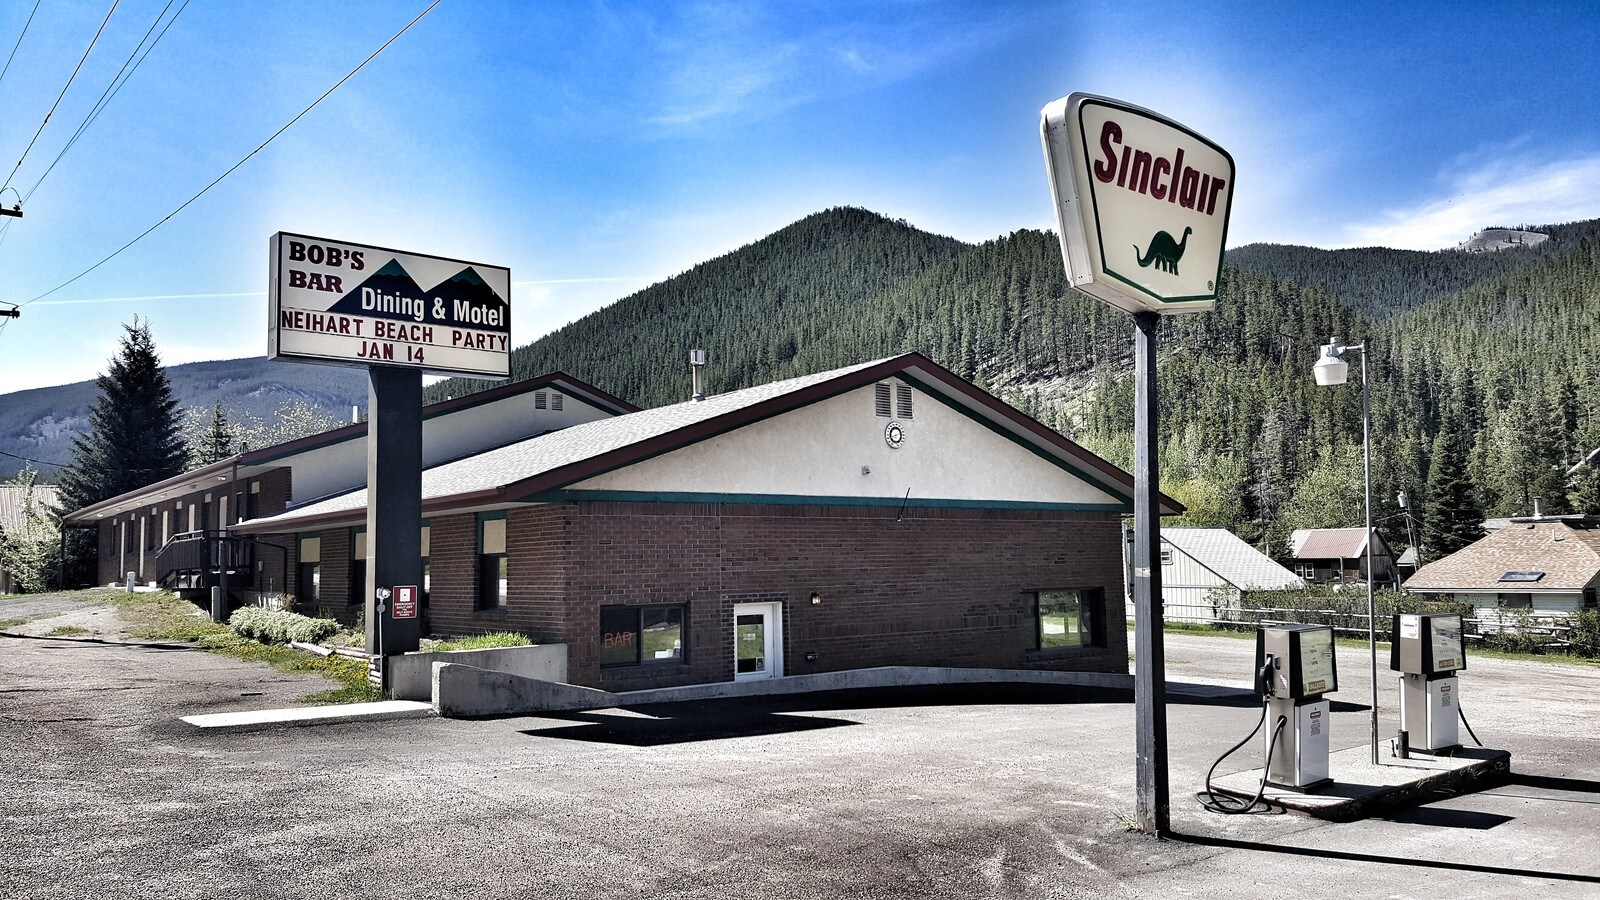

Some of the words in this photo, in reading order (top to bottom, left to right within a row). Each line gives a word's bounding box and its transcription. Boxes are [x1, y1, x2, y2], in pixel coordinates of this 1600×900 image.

[1094, 120, 1226, 216] Sinclair
[288, 240, 365, 271] BOB'S
[288, 269, 343, 294] BAR
[361, 286, 425, 322] Dining
[431, 296, 446, 320] &
[453, 299, 504, 327] Motel
[281, 310, 364, 336] NEIHART
[374, 320, 433, 343] BEACH
[452, 329, 508, 351] PARTY
[357, 340, 394, 360] JAN
[407, 345, 425, 363] 14
[604, 631, 632, 649] BAR
